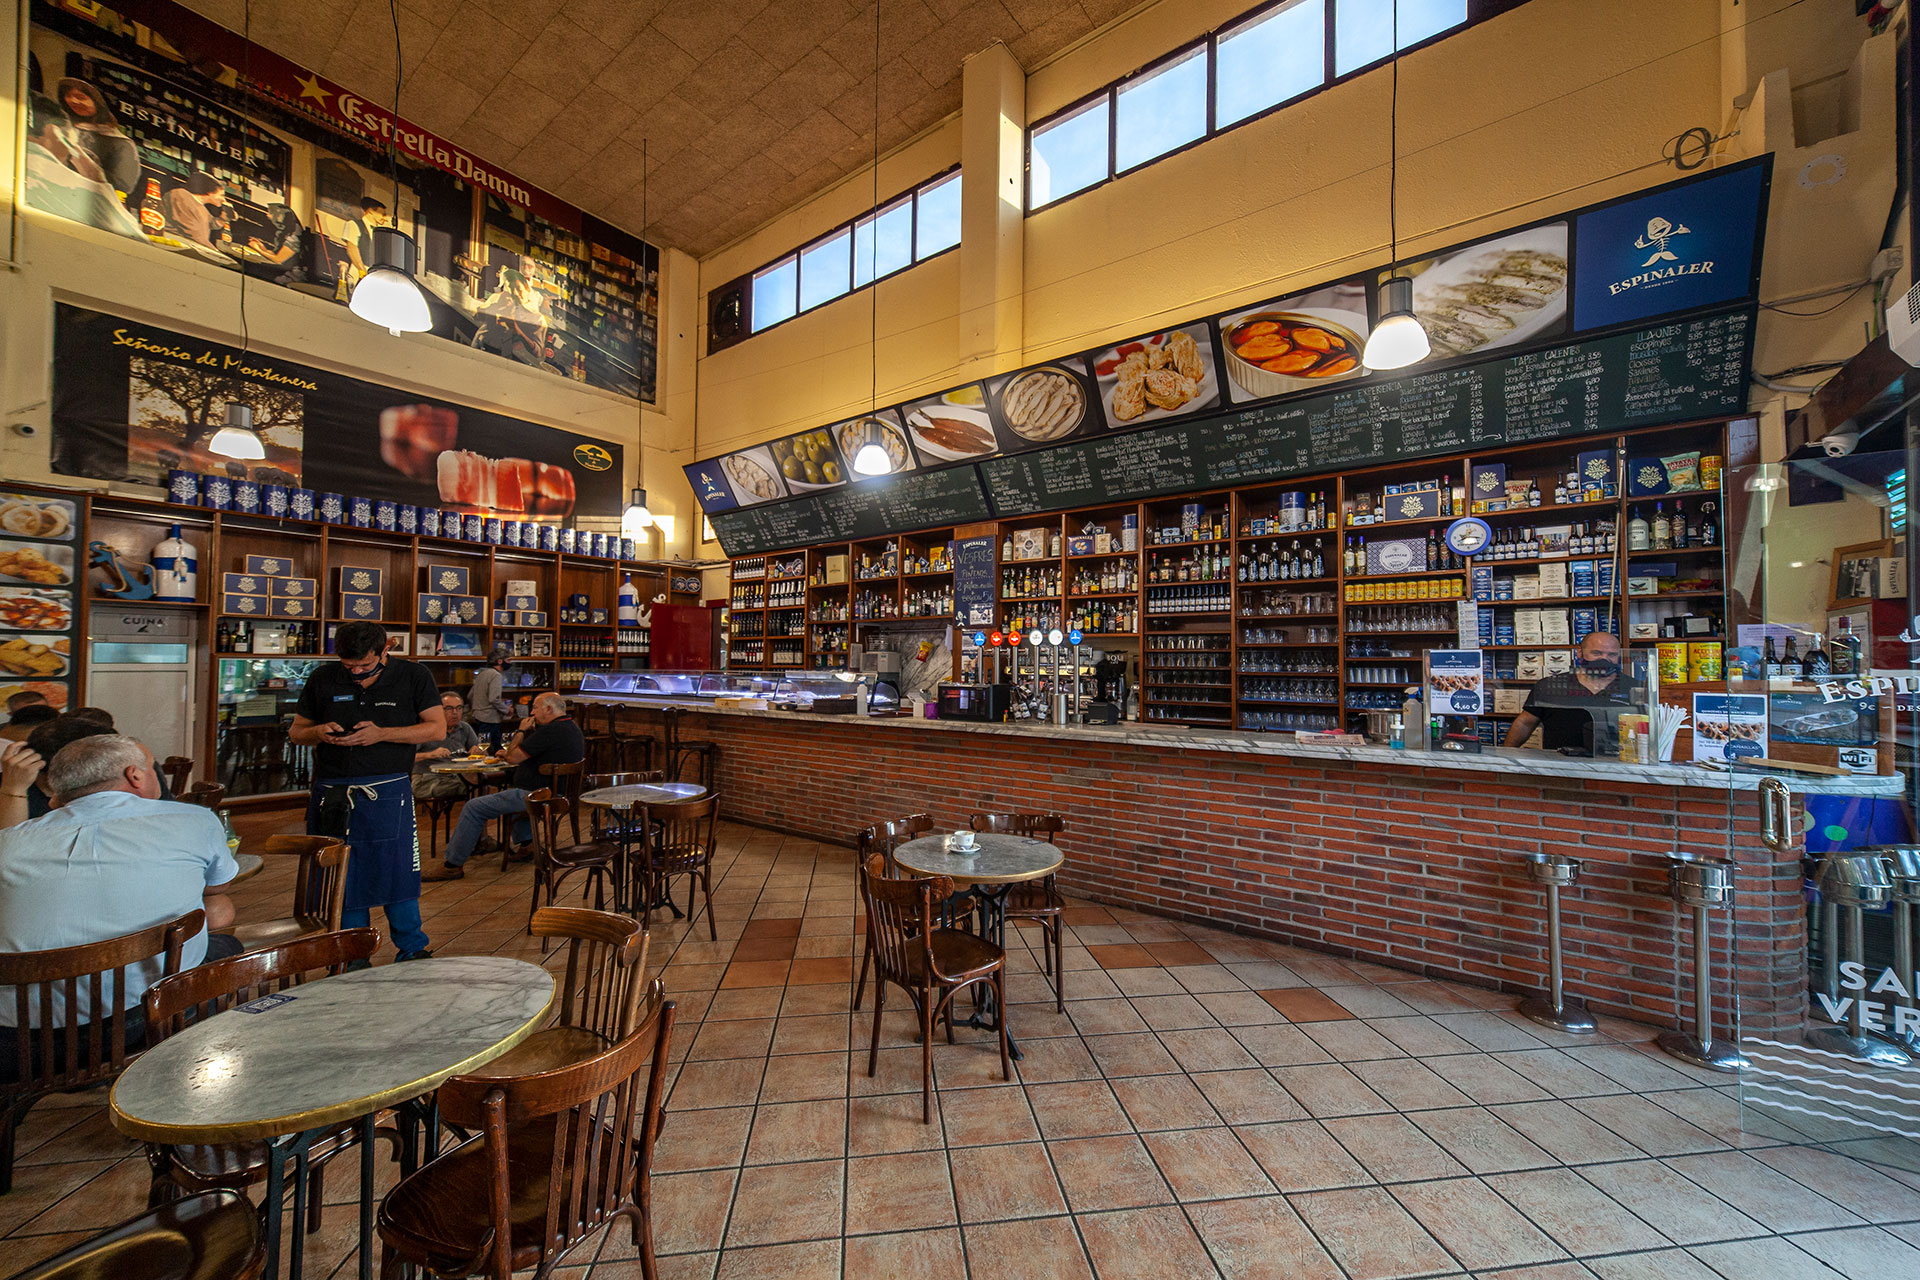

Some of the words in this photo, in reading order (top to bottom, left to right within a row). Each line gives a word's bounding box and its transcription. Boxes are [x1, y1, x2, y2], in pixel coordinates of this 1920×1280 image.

[118, 99, 258, 168] ESPINALER
[338, 93, 451, 168] Estrella
[452, 149, 531, 207] Damm
[1608, 261, 1714, 296] ESPINALER
[195, 350, 218, 367] de
[223, 354, 318, 391] Montanera
[1510, 353, 1538, 367] TAPES
[122, 616, 163, 624] CUINA
[1453, 701, 1470, 710] 4,60
[1839, 960, 1920, 999] SA
